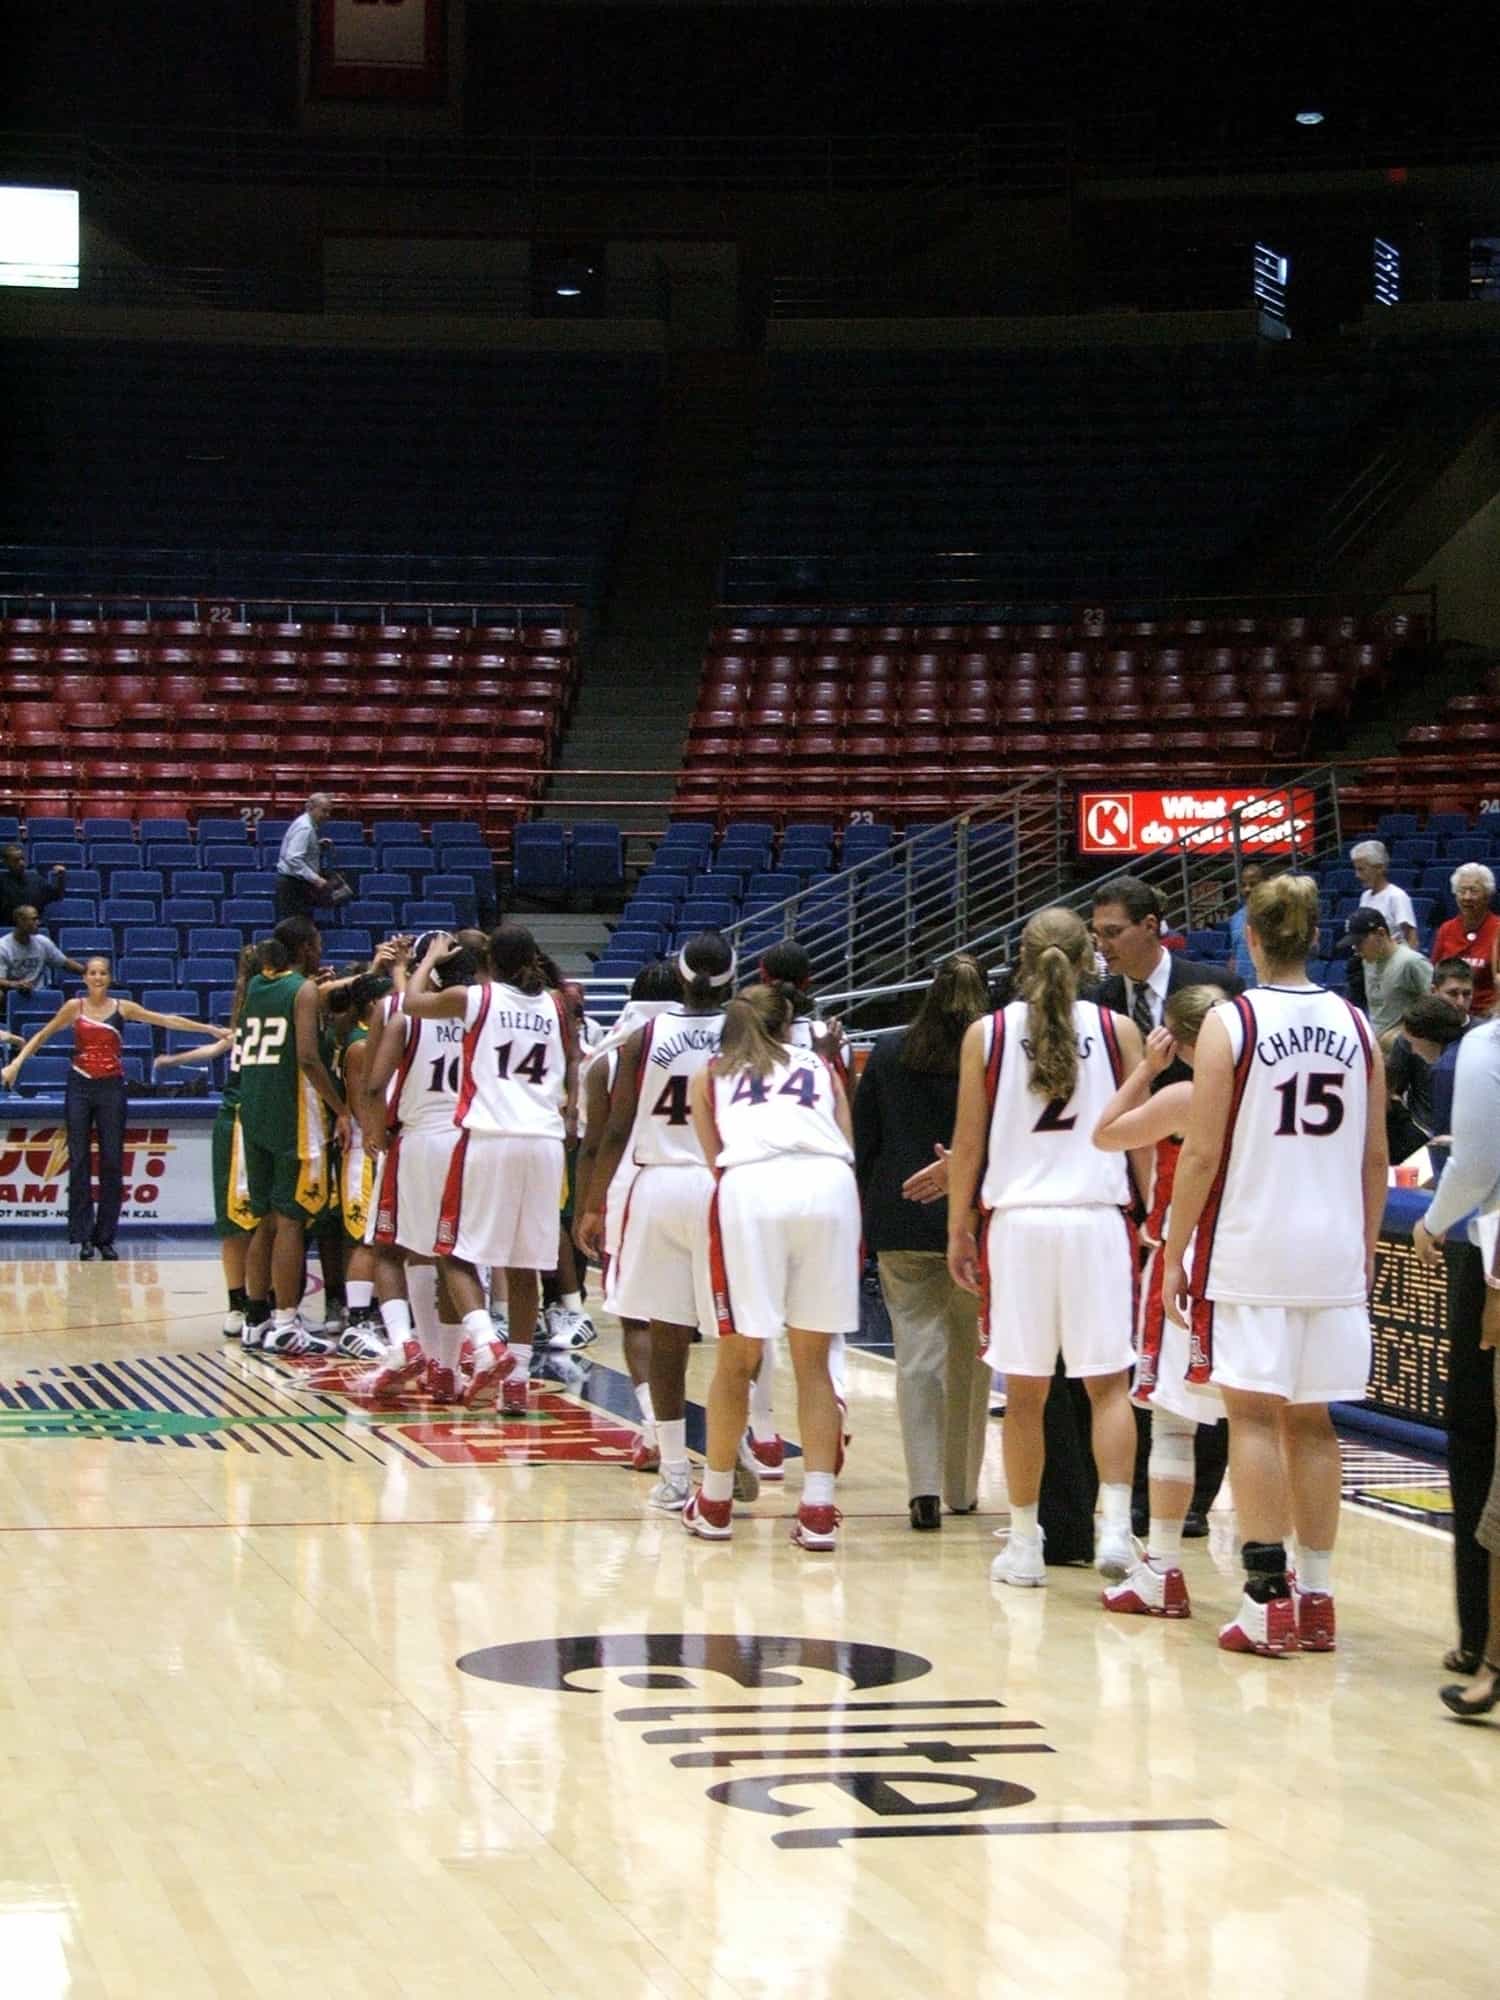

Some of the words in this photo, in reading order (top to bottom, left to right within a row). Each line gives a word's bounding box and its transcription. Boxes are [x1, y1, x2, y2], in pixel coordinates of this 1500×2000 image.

[209, 607, 233, 623] 22
[1083, 608, 1105, 625] 23
[1161, 796, 1227, 821] What
[1140, 820, 1174, 843] do
[1177, 825, 1225, 847] you
[240, 1016, 288, 1065] 22
[436, 1025, 465, 1043] PAC
[499, 1010, 553, 1036] FIELDS
[493, 1039, 550, 1085] 14
[1257, 1026, 1359, 1069] CHAPPELL
[651, 1074, 692, 1126] 4
[730, 1066, 822, 1110] 44
[1273, 1071, 1346, 1137] 15
[456, 1633, 1229, 1850] alltel
